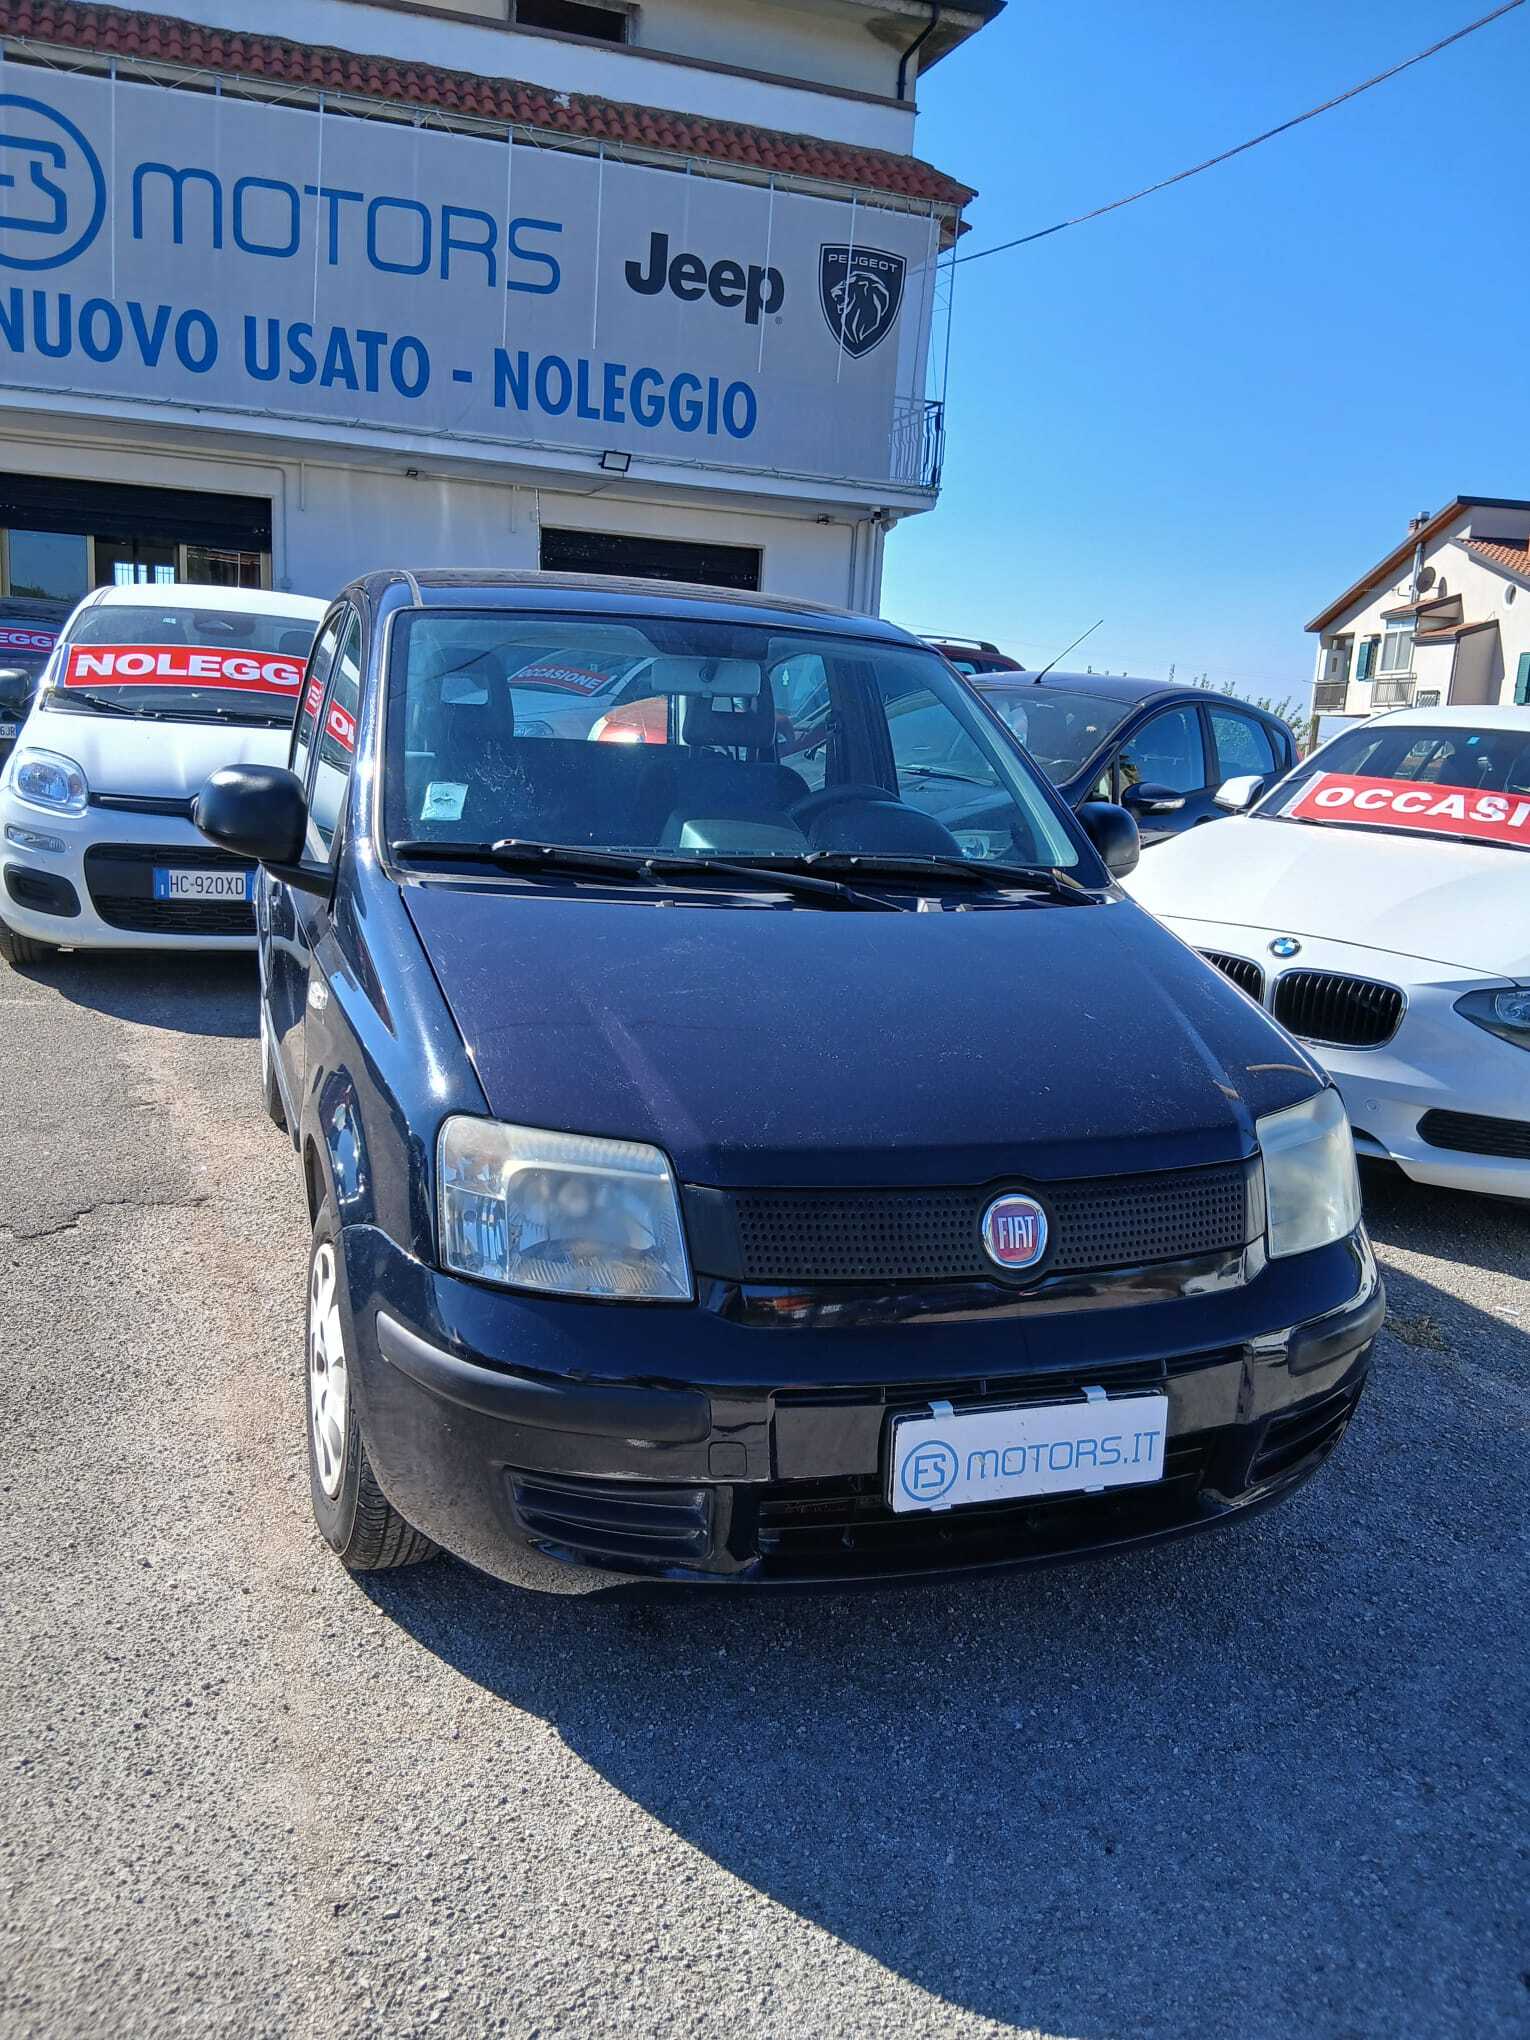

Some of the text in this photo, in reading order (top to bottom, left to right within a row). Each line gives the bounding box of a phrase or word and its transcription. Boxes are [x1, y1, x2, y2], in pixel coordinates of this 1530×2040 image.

[625, 231, 785, 325] Jeep
[828, 254, 898, 273] PEUGEOT
[0, 287, 218, 374] NUOVO
[244, 315, 430, 398] USATO
[494, 347, 757, 440] NOLEGGIO
[75, 653, 305, 686] NOLEGG
[1315, 787, 1530, 828] OCCASI
[998, 1215, 1034, 1249] FIAT
